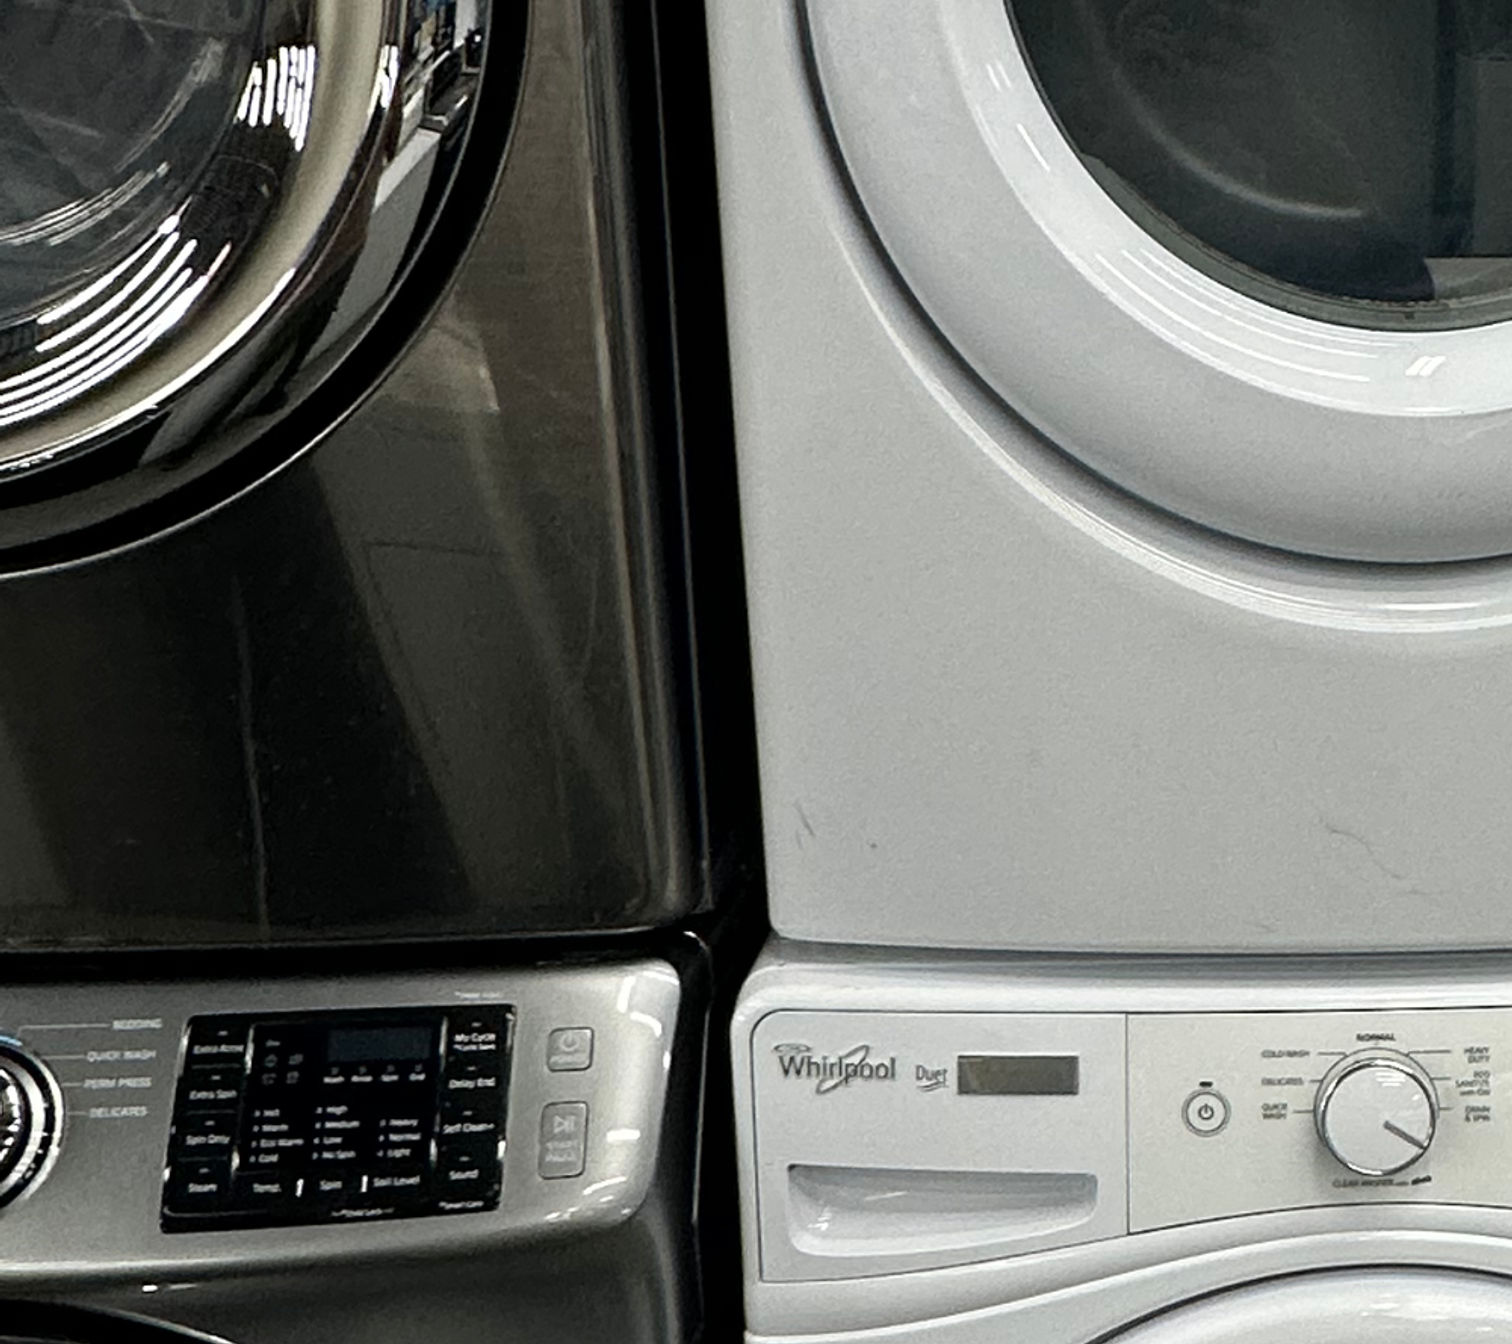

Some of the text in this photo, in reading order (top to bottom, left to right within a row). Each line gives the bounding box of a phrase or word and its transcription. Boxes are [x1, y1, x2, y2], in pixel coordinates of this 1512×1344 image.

[1356, 1032, 1396, 1042] NORMAL
[87, 1049, 156, 1062] QUICK WASH
[1464, 1046, 1490, 1054] HEAVY
[1467, 1055, 1490, 1064] DUTY
[776, 1049, 897, 1089] Whirlpool
[915, 1064, 948, 1085] Duet
[448, 1076, 496, 1089] Delay End
[189, 1088, 238, 1100] Extra Spin
[89, 1106, 148, 1118] DELICATES
[186, 1135, 207, 1145] Spin
[373, 1174, 421, 1187] Soil Level
[449, 1169, 479, 1180] Sound
[188, 1182, 218, 1193] Steam
